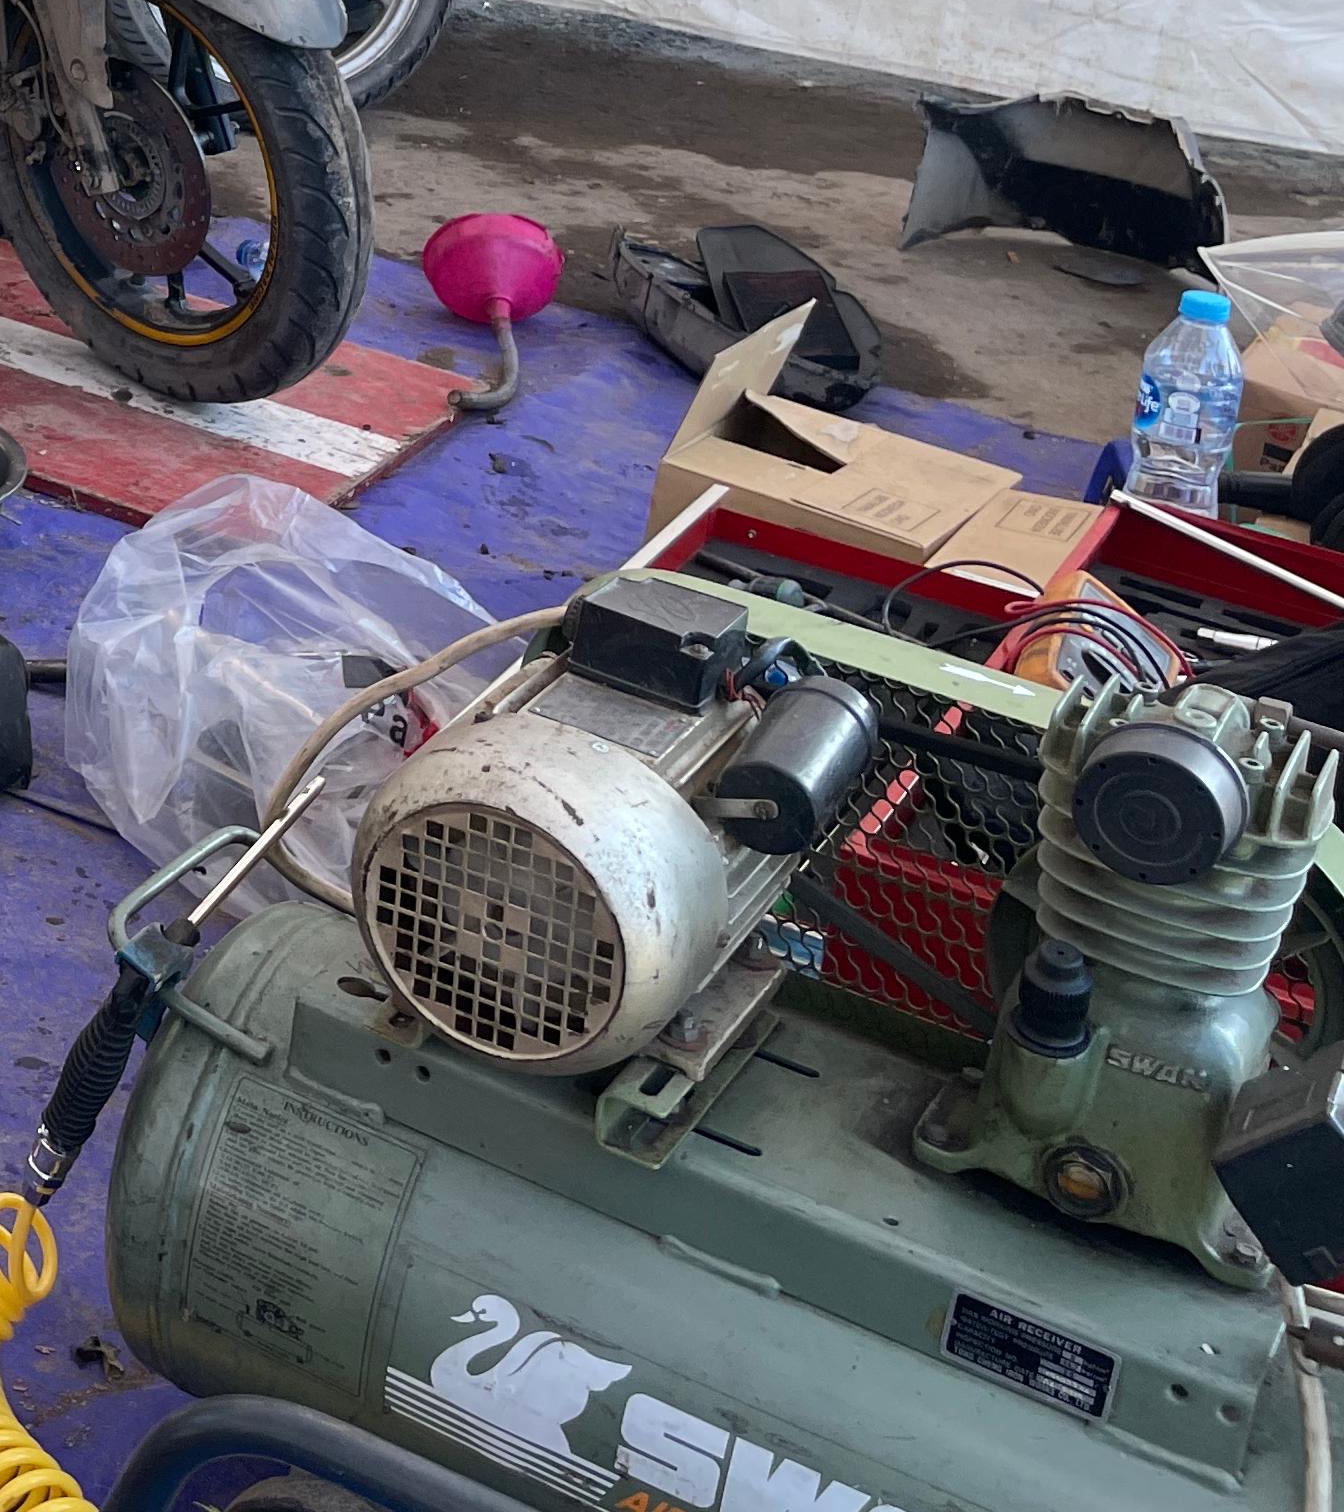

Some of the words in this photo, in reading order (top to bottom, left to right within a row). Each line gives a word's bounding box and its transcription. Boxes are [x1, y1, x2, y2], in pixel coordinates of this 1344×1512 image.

[283, 1100, 369, 1147] INSTRUCTIONS
[989, 1308, 1013, 1326] AIR
[1017, 1320, 1083, 1356] RECEIVER
